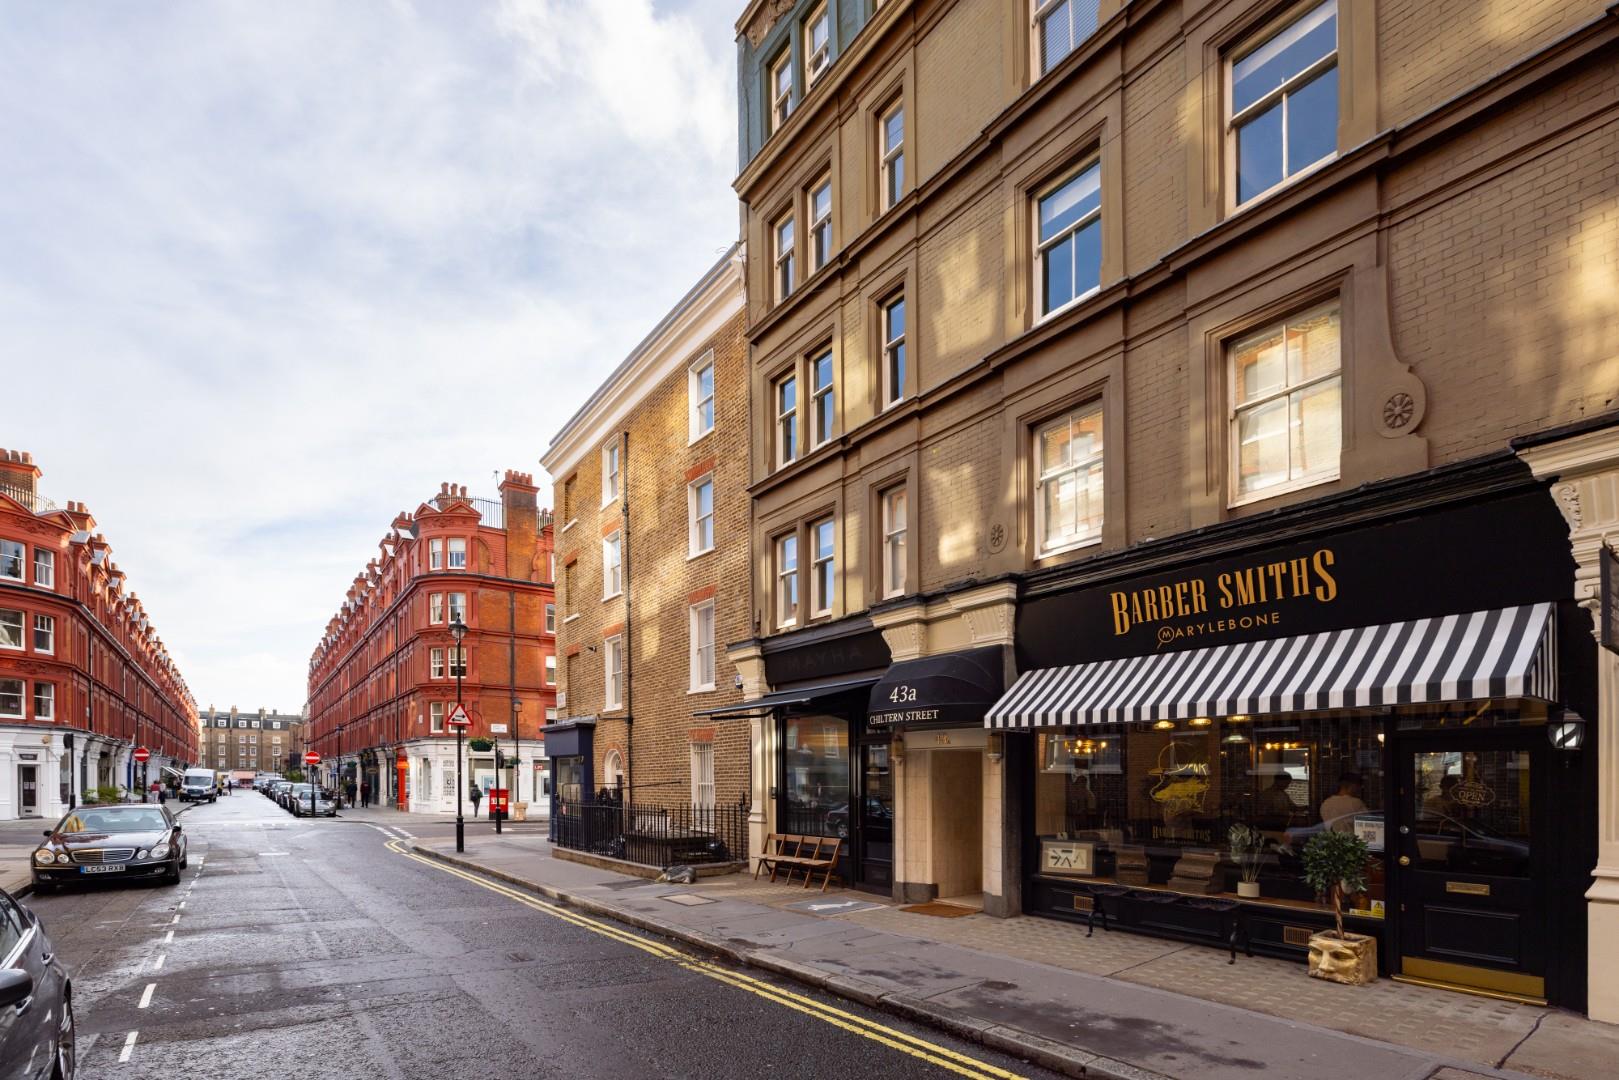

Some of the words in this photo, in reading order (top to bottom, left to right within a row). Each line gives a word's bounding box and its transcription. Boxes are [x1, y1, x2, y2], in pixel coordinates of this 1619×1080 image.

[1110, 578, 1208, 636] BARBER
[1217, 549, 1338, 602] SMITHS
[1158, 612, 1281, 642] MARYLEBONE
[889, 685, 917, 703] 43a
[869, 711, 904, 725] CHILTERN
[905, 709, 939, 721] STREET
[1458, 789, 1486, 801] OPEN
